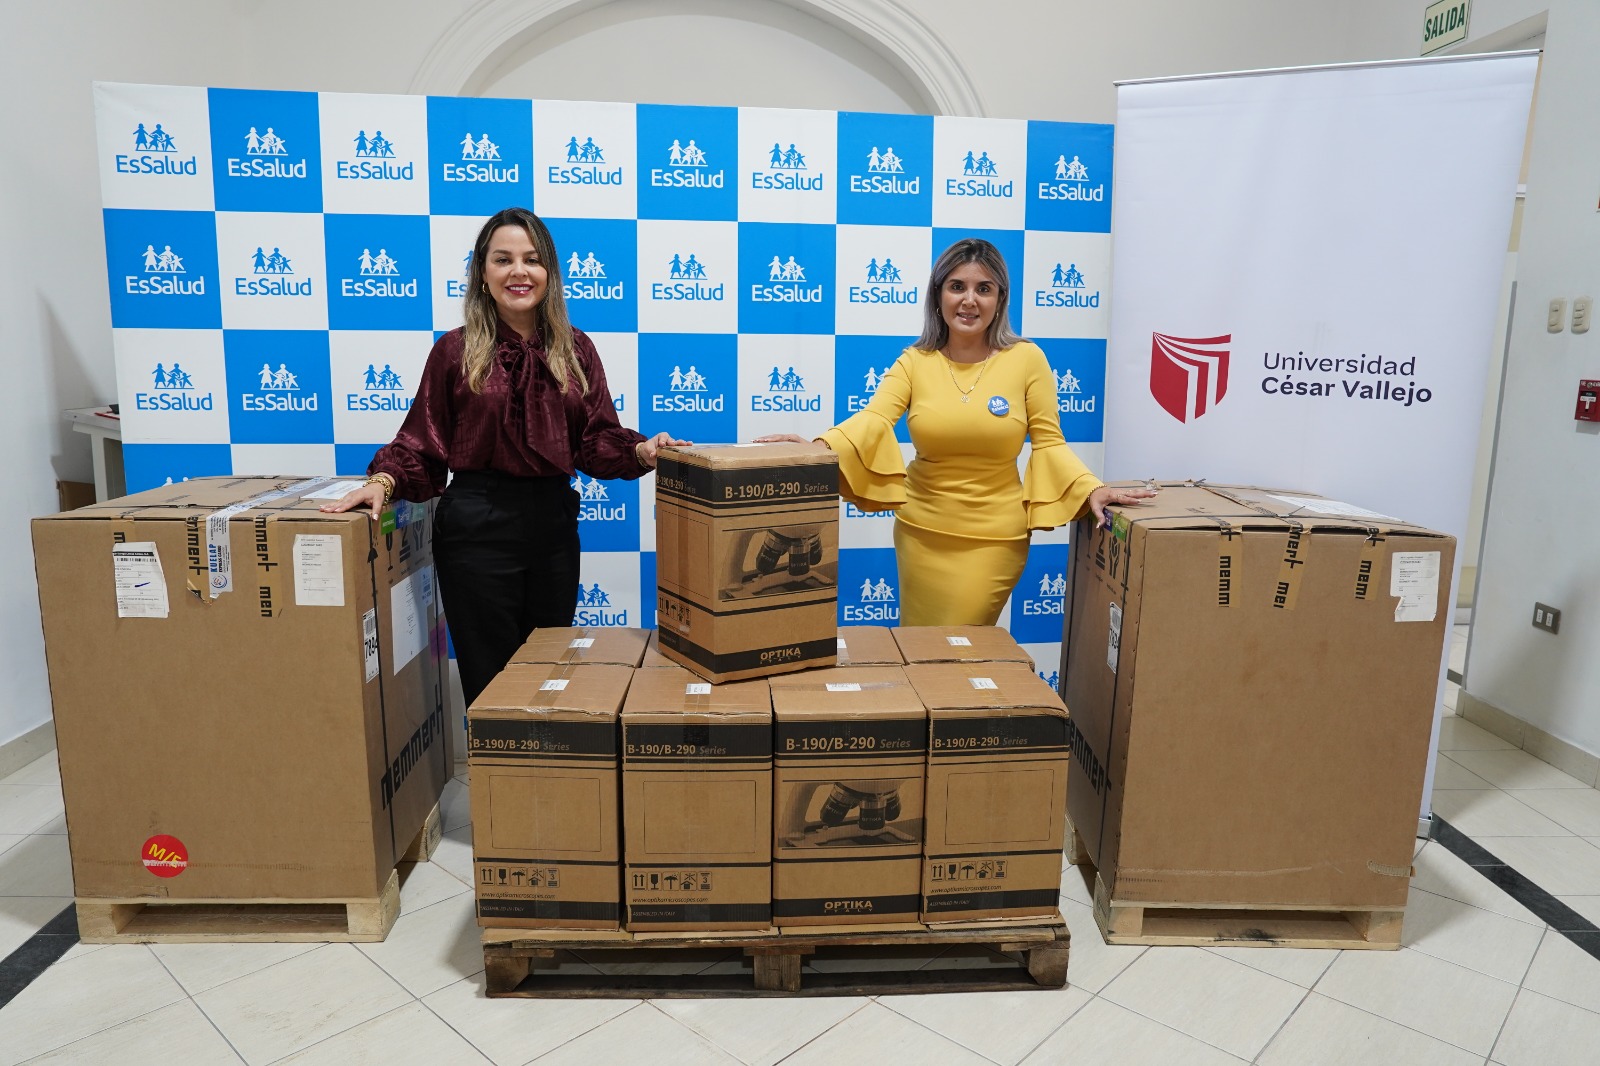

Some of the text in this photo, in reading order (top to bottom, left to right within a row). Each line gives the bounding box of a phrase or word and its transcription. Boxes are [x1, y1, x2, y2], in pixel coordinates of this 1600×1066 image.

[1424, 3, 1465, 42] SALIDA
[116, 155, 196, 175] EsSalud
[228, 158, 306, 178] EsSalud
[337, 161, 413, 180] EsSalud
[444, 164, 518, 182] EsSalud
[549, 167, 622, 185] EsSalud
[652, 169, 723, 188] EsSalud
[753, 172, 822, 190] EsSalud
[851, 175, 919, 194] EsSalud
[947, 179, 1012, 197] EsSalud
[1039, 182, 1103, 201] EsSalud
[126, 276, 205, 295] EsSalud
[235, 278, 311, 296] EsSalud
[342, 278, 417, 297] EsSalud
[563, 281, 623, 300] sSalud
[652, 283, 723, 300] EsSalud
[752, 284, 822, 302] EsSalud
[850, 287, 917, 304] EsSalud
[1036, 291, 1099, 308] EsSalud
[1264, 351, 1416, 376] Universidad
[1261, 375, 1432, 407] César Vallejo
[136, 393, 212, 410] EsSalud
[243, 393, 317, 411] EsSalud
[653, 394, 723, 412] EsSalud
[752, 395, 820, 411] EsSalud
[725, 481, 829, 499] B-190/B-290 Series
[577, 503, 626, 521] Salud
[209, 544, 218, 573] KUELAP
[844, 603, 900, 620] EsSalu
[1023, 598, 1065, 615] EsSal
[572, 609, 627, 627] sSalud
[760, 647, 801, 660] OPTIKA
[473, 738, 570, 751] B-190/B-290 Series
[627, 744, 727, 755] B-190/B-290 Series
[786, 736, 911, 751] B-190/B-290 Series
[934, 736, 1028, 748] B-190/B-290 Series
[824, 900, 873, 909] OPTIKA
